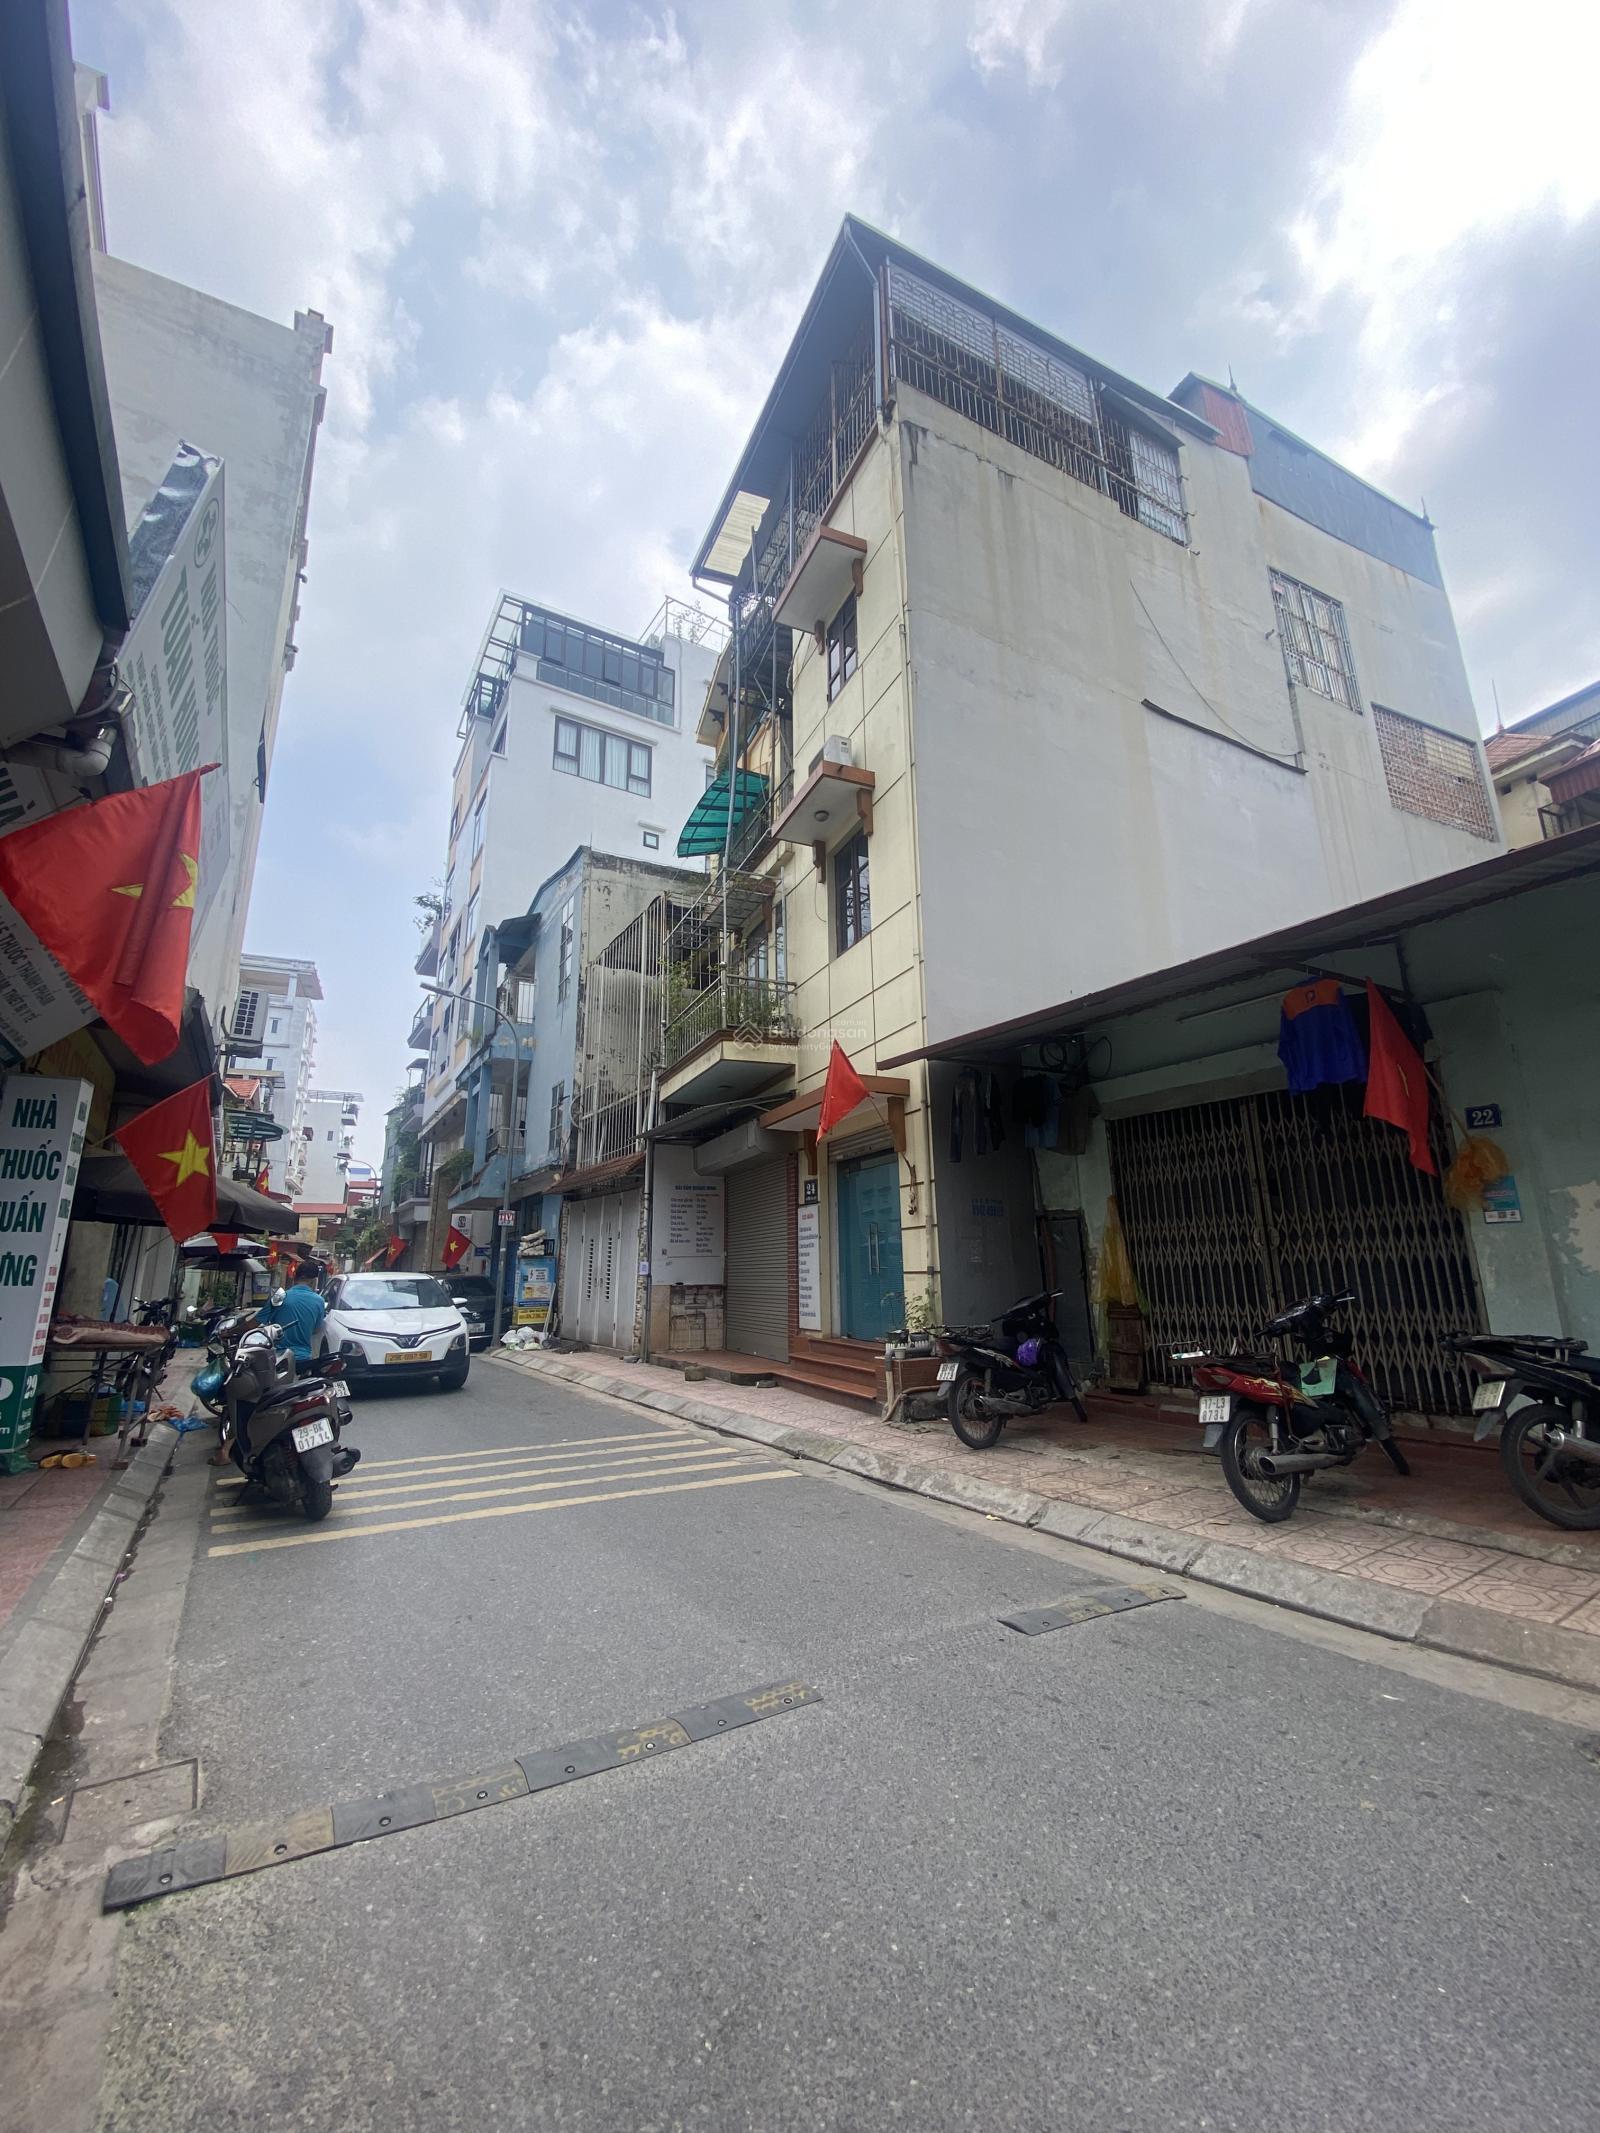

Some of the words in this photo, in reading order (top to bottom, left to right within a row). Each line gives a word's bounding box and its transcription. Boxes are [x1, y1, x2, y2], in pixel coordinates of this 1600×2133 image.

[12, 1094, 57, 1129] NHÀ
[1472, 1109, 1495, 1126] 22
[0, 1190, 47, 1233] UẤN
[297, 1421, 324, 1439] 29-BK
